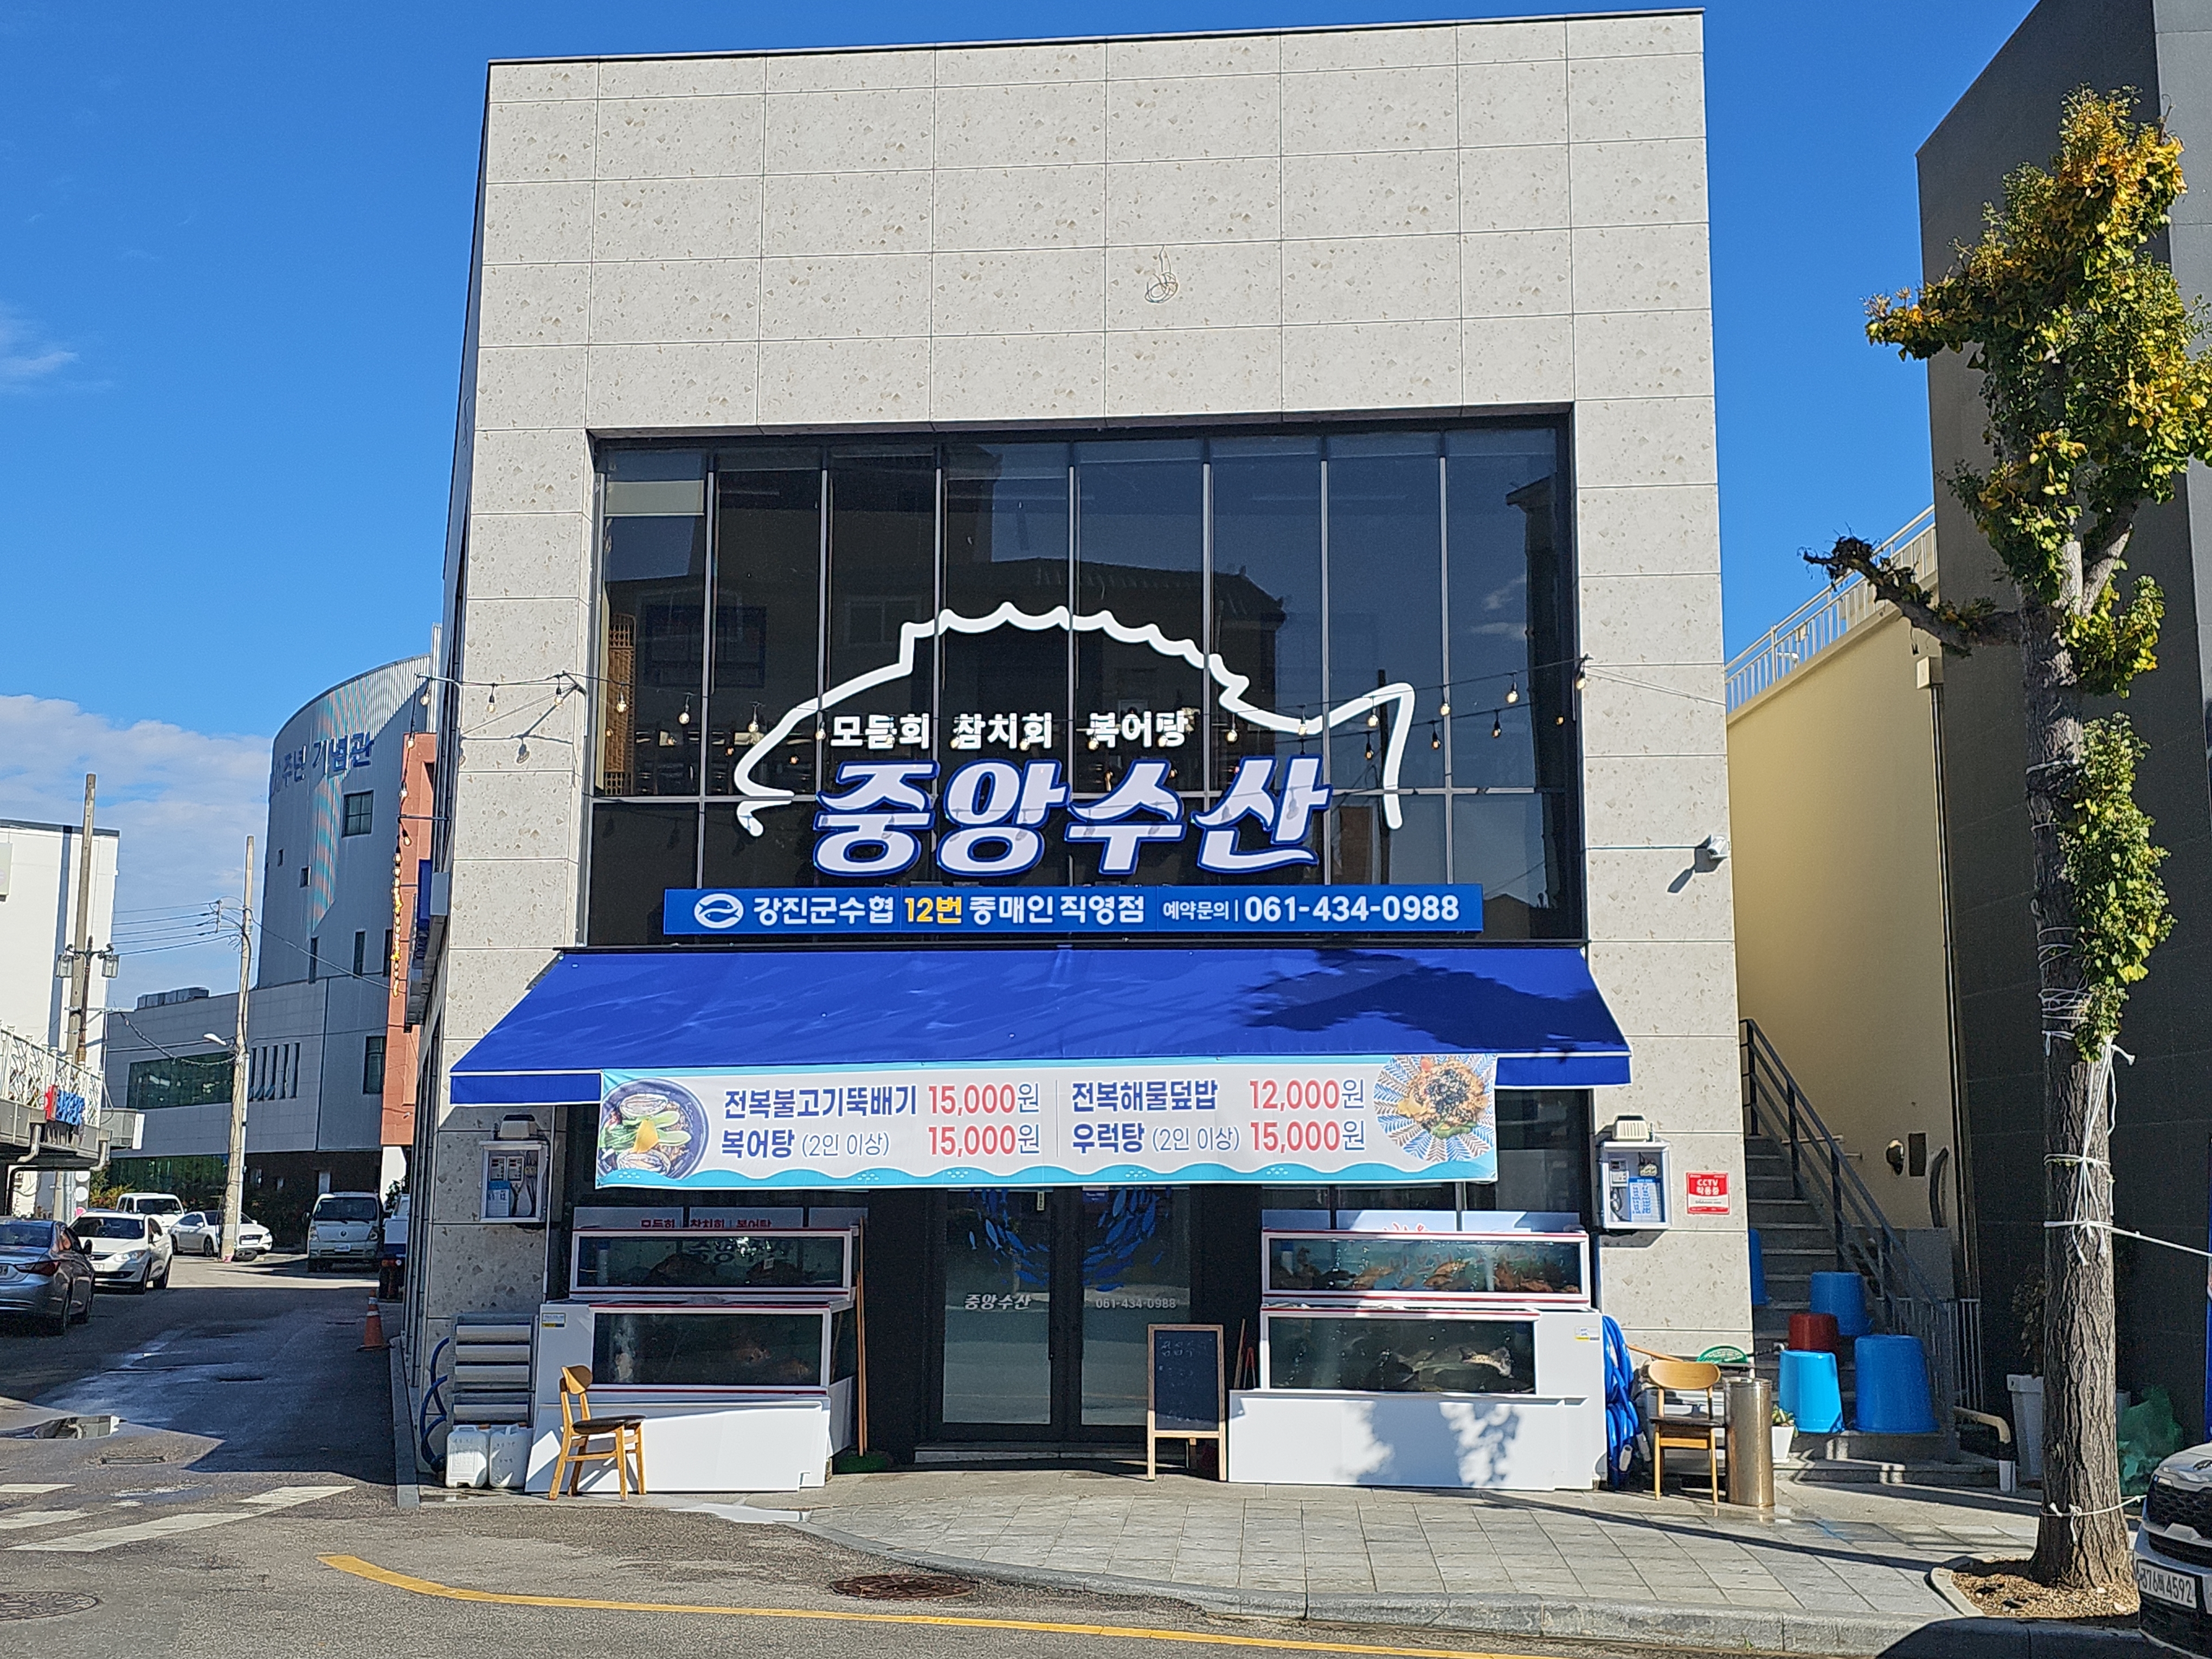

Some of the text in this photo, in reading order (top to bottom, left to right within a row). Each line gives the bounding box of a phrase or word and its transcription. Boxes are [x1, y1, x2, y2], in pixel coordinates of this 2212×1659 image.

[830, 712, 1189, 749] 모듬회 참치회 복어탕
[312, 732, 375, 775] 기념관
[813, 756, 1333, 877] 중앙수산
[753, 895, 1459, 926] 강진군수협 12번 중매인 직영점 예약문의 061-434-0988
[724, 1083, 1039, 1120] 전복불고기뚝배기 15,000원
[1072, 1079, 1365, 1112] 전복해물덮밥 12,000원
[722, 1124, 1040, 1159] 복어탕 (2인 이상) 15,000원
[1072, 1120, 1366, 1154] 우럭탕 (2인 이상) 15,000원
[964, 1294, 1031, 1310] 중앙수산
[1096, 1298, 1177, 1309] 061-434-0988
[2166, 1574, 2193, 1604] 4592
